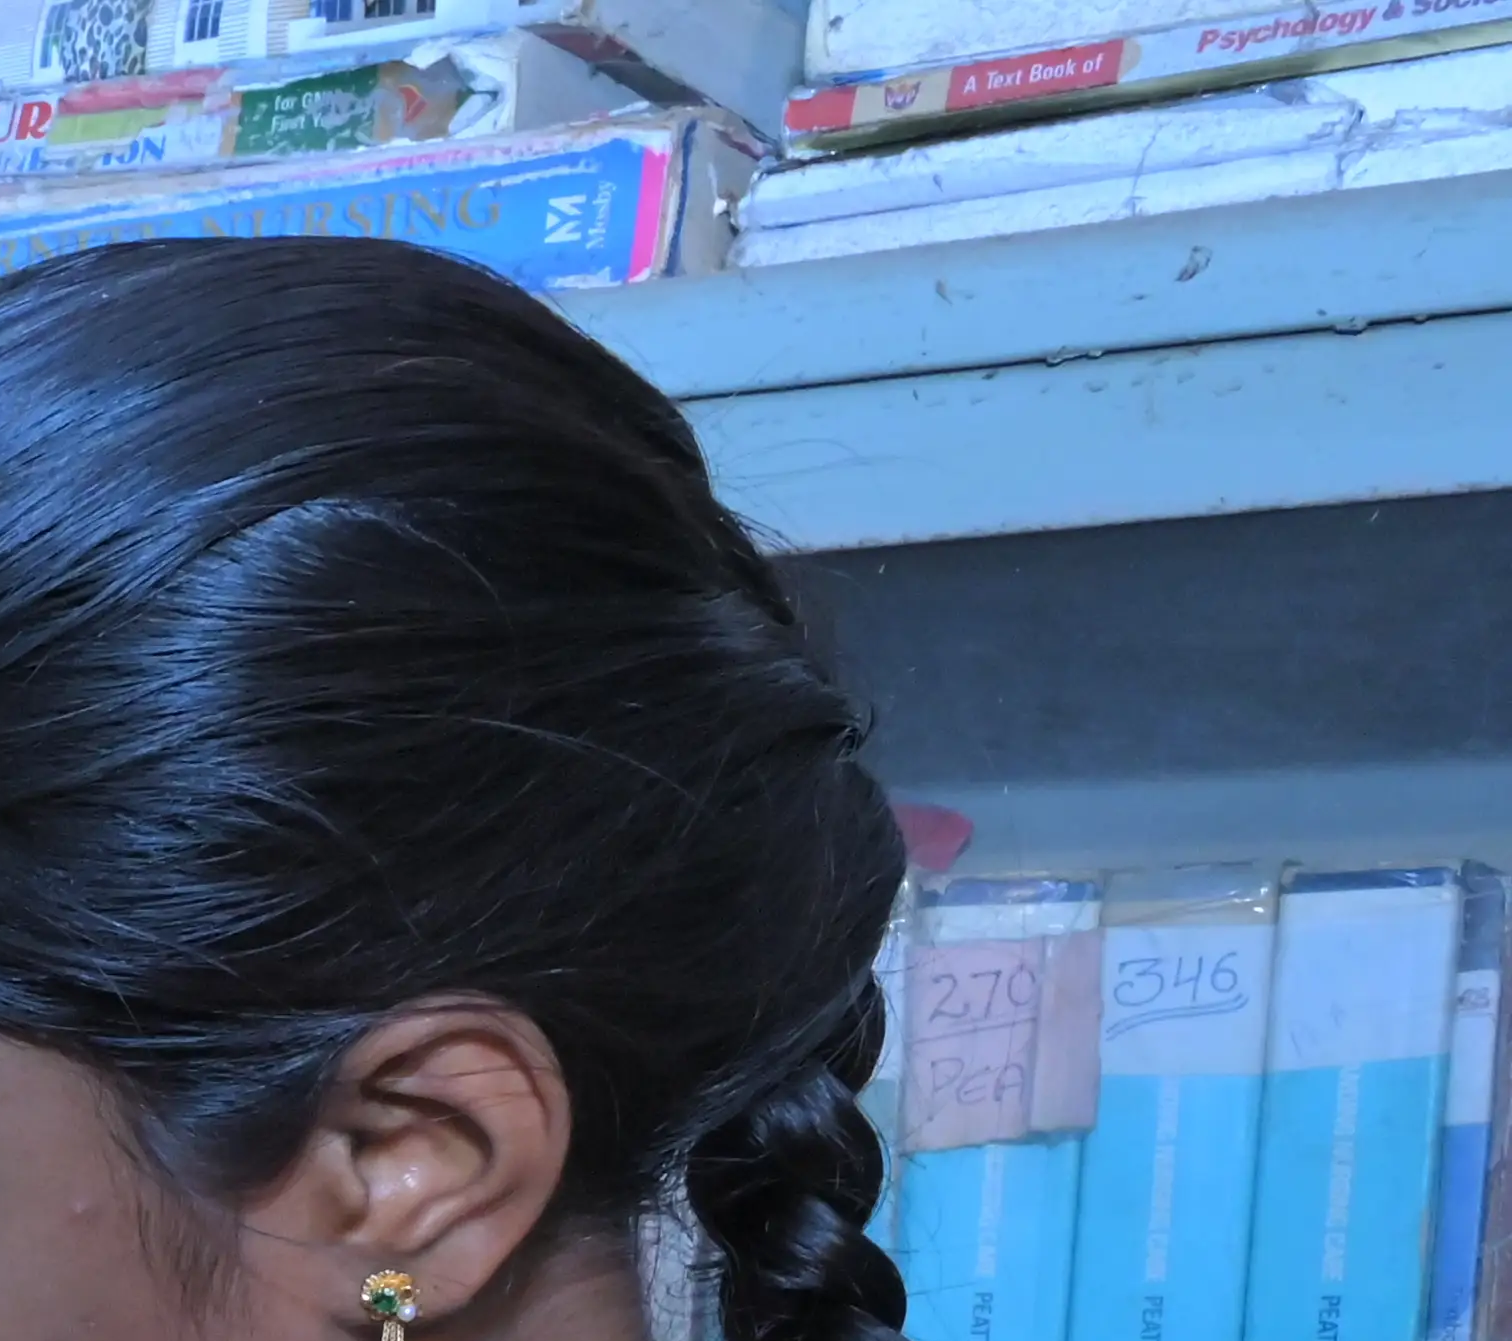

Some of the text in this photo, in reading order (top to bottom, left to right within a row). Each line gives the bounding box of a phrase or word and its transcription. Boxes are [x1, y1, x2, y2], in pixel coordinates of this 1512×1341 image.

[964, 3, 1376, 95] A Text Book of Psychology
[586, 178, 615, 250] Mosby
[1113, 951, 1241, 1008] 346
